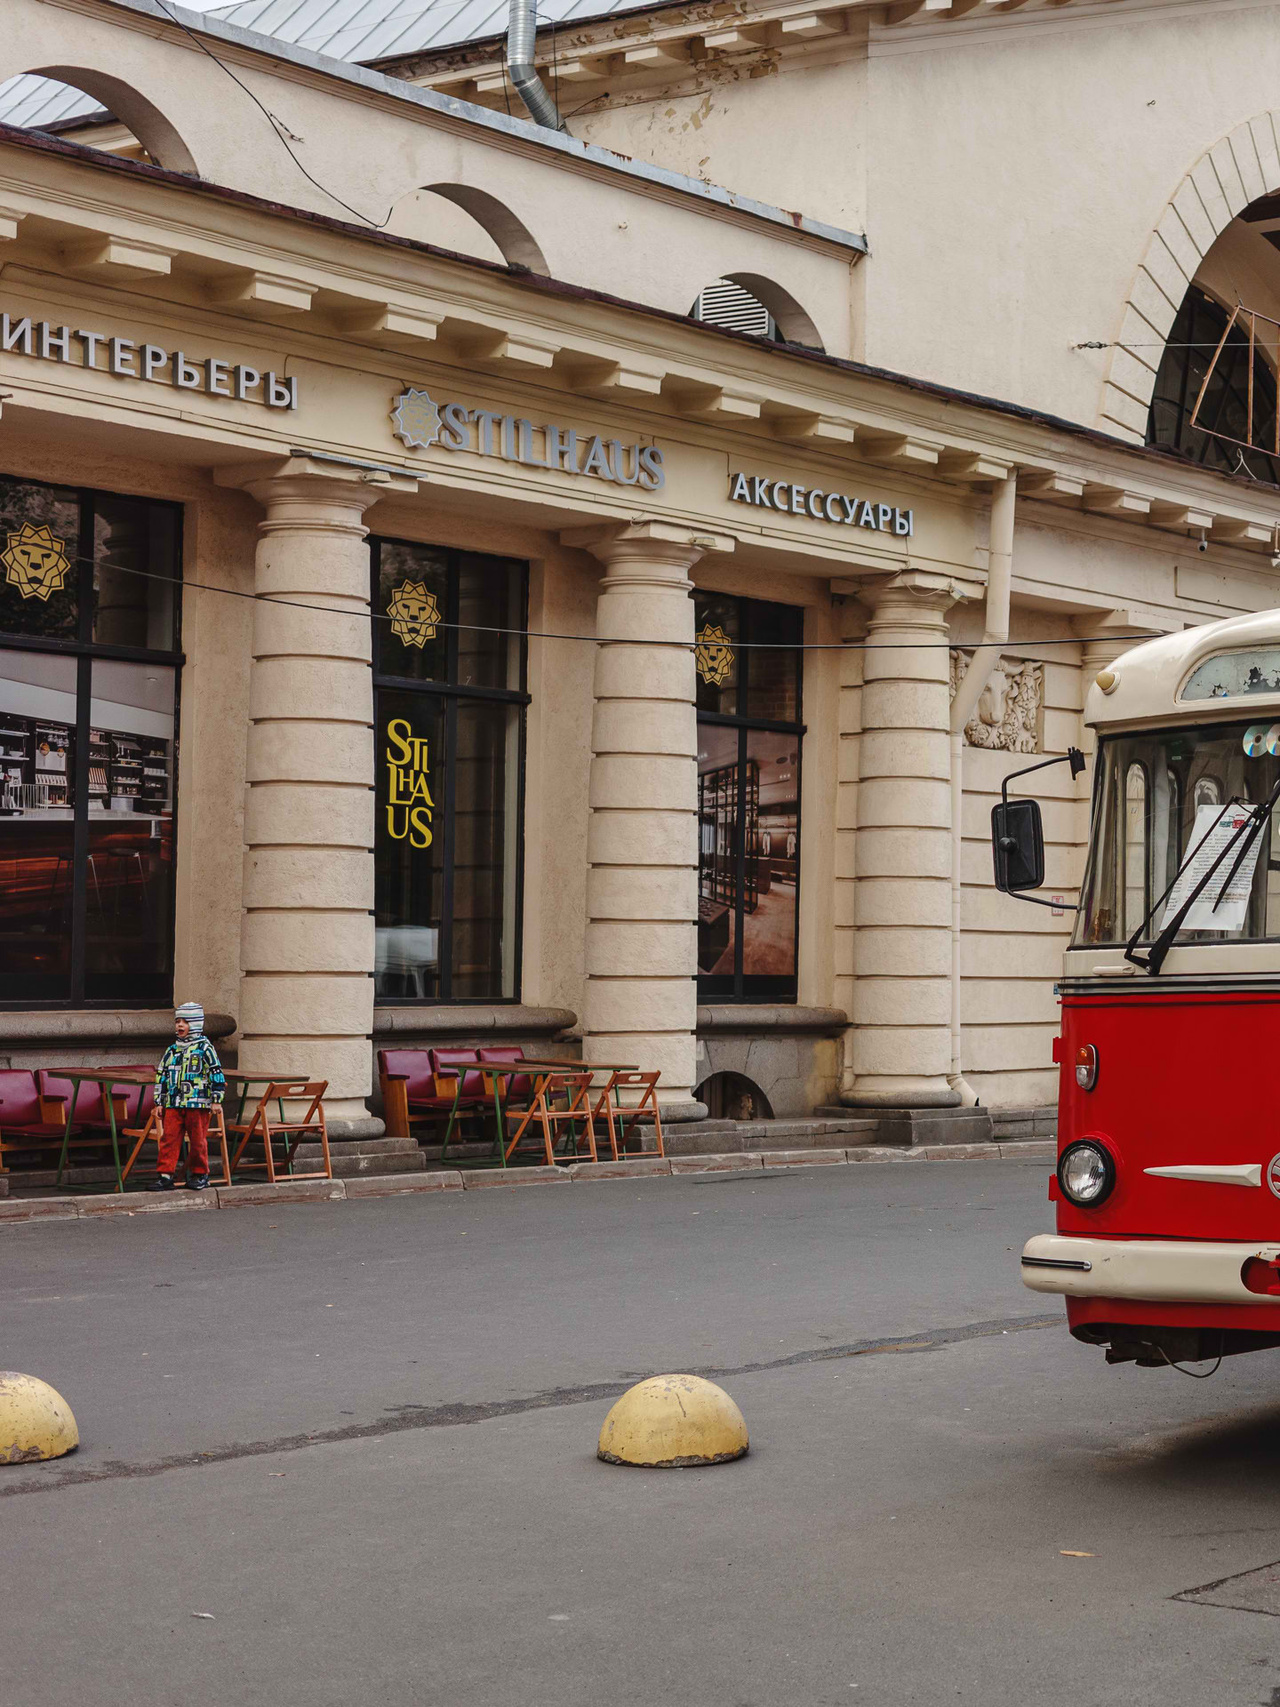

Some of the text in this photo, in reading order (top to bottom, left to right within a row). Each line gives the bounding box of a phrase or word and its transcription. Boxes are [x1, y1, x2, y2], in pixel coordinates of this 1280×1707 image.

[0, 312, 298, 411] ИНТЕРЬЕРЫ
[440, 402, 666, 490] STILHAUS
[730, 472, 914, 537] АКСЕССУАРЫ
